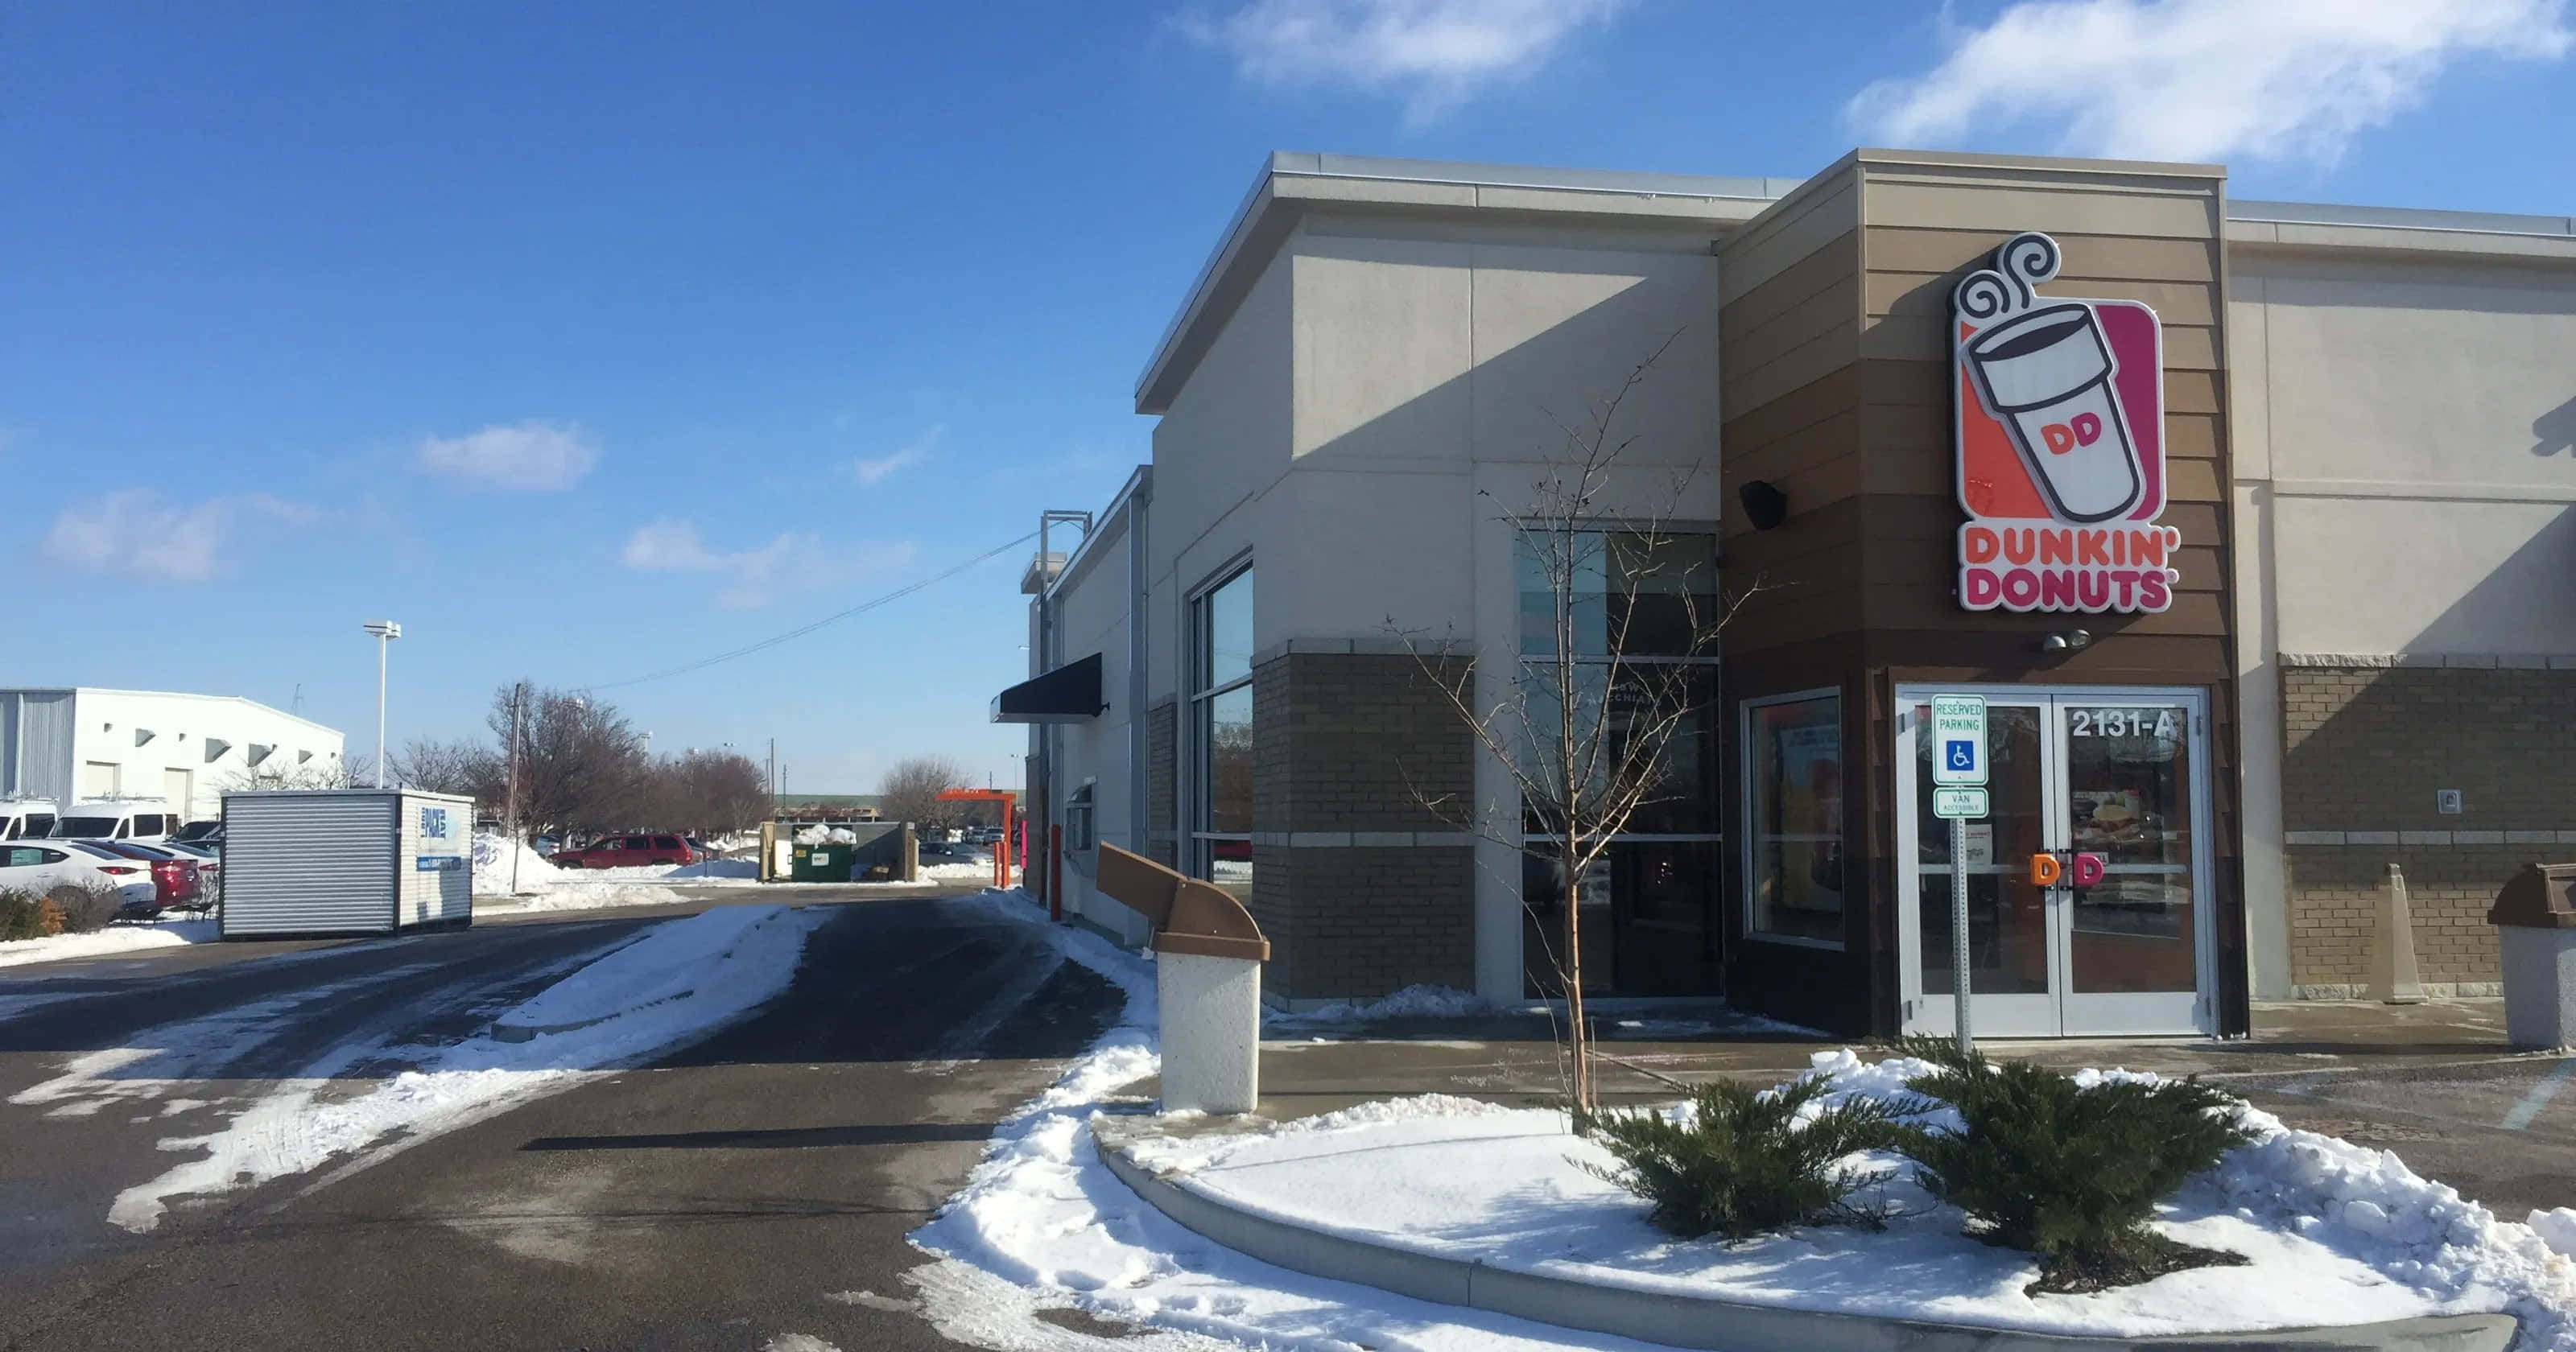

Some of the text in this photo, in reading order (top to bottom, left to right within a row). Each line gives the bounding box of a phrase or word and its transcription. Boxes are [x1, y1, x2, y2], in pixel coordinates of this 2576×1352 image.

[2041, 412, 2101, 455] DD
[1965, 527, 2176, 566] DUNKIN'
[1967, 568, 2167, 608] DONUTS
[1936, 703, 1982, 715] RESERVED
[1940, 719, 1979, 731] PARKING
[2073, 711, 2178, 737] 2131-A
[1952, 795, 1970, 803] VAN
